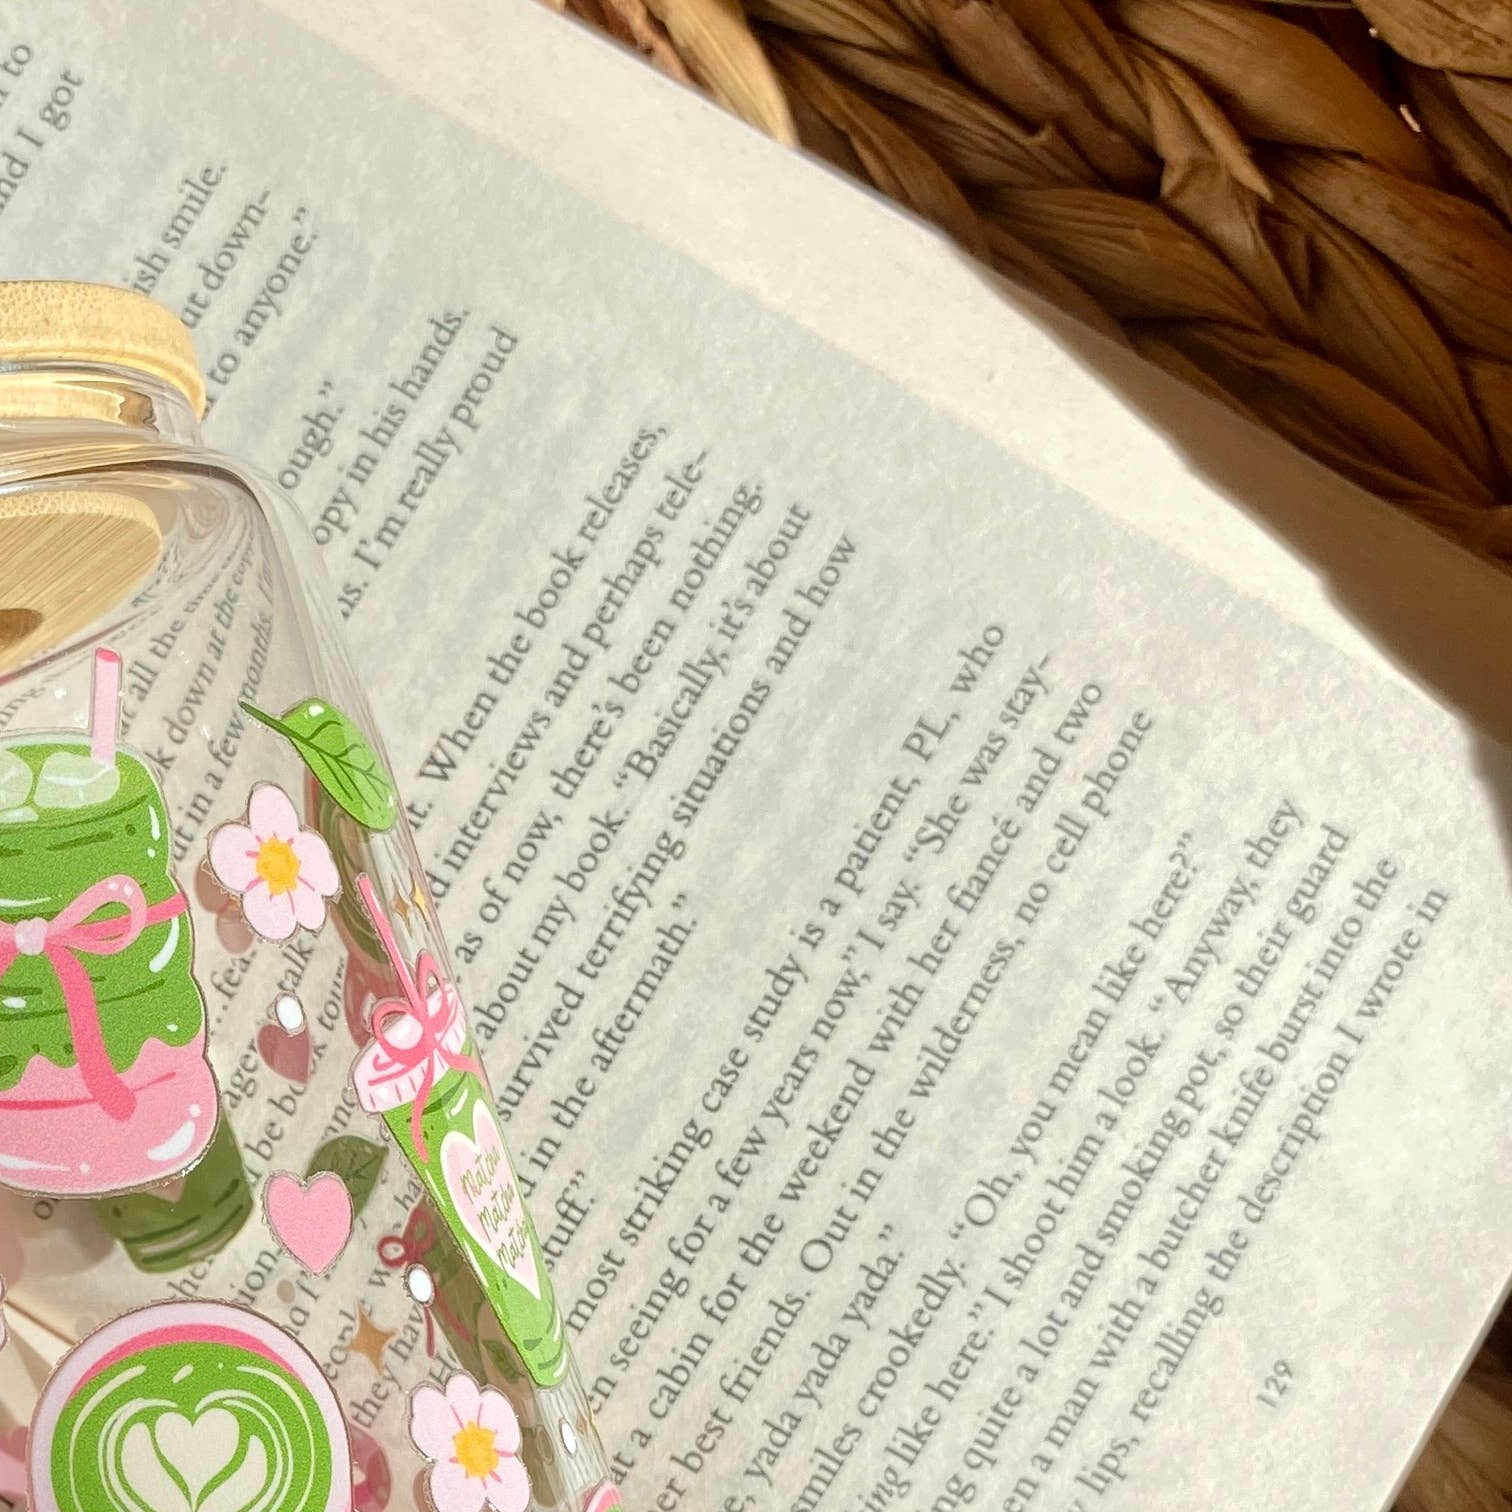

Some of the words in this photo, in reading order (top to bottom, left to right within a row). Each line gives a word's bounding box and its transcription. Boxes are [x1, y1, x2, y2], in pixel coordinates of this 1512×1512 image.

[14, 126, 44, 151] I
[38, 69, 83, 132] got
[161, 165, 227, 249] smile.
[196, 189, 271, 291] down-
[205, 351, 241, 386] to
[233, 206, 319, 346] anyone.”
[387, 309, 471, 402] hands.
[336, 451, 379, 487] in
[351, 514, 408, 572] I’m
[396, 424, 463, 513] really
[448, 324, 519, 432] proud
[357, 403, 407, 450] his
[743, 503, 811, 596] about
[415, 690, 500, 781] When
[485, 633, 533, 686] the
[512, 546, 587, 630] book
[576, 426, 666, 543] releases,
[716, 598, 754, 642] it’s
[432, 710, 551, 873] interviews
[544, 642, 591, 708] and
[580, 526, 664, 651] perhaps
[655, 450, 708, 521] tele-
[453, 931, 484, 964] as
[477, 874, 511, 924] of
[501, 809, 564, 885] now,
[549, 701, 625, 800] there’s
[606, 618, 677, 695] been
[668, 484, 763, 613] nothing.
[612, 647, 729, 789] “Basically,
[494, 980, 585, 1122] survived
[575, 829, 687, 980] terrifying
[672, 680, 770, 828] situations
[765, 608, 812, 674] and
[793, 534, 855, 608] how
[552, 808, 631, 893] book.
[1242, 798, 1304, 869] they
[530, 893, 577, 949] my
[1147, 875, 1261, 1013] “Anyway,
[471, 946, 541, 1041] about
[559, 1248, 626, 1335] most
[618, 1117, 714, 1246] striking
[700, 1047, 750, 1113] case
[742, 952, 809, 1043] study
[789, 923, 826, 950] is
[818, 896, 842, 916] a
[833, 777, 921, 897] patient,
[901, 712, 960, 762] PL,
[949, 624, 1005, 692] who
[519, 1136, 562, 1172] in
[549, 1075, 597, 1130] the
[590, 892, 697, 1072] aftermath.”
[1096, 1032, 1166, 1109] look.
[856, 1257, 966, 1418] crookedly.
[948, 1171, 1023, 1240] “Oh,
[1008, 1099, 1057, 1166] you
[1047, 1007, 1112, 1095] mean
[1090, 944, 1147, 1005] like
[1127, 831, 1198, 941] here?”
[1043, 1132, 1106, 1199] him
[1094, 1111, 1118, 1131] a
[1073, 1435, 1141, 1496] lips,
[1128, 1285, 1225, 1423] recalling
[1203, 1228, 1250, 1282] the
[1235, 1050, 1354, 1224] description
[1332, 1022, 1365, 1045] I
[1354, 928, 1423, 1018] wrote
[1414, 888, 1449, 925] in
[998, 1197, 1067, 1289] shoot
[981, 1284, 1013, 1308] I
[922, 1301, 995, 1403] here.”
[1255, 1358, 1294, 1408] 129
[883, 1404, 942, 1468] like
